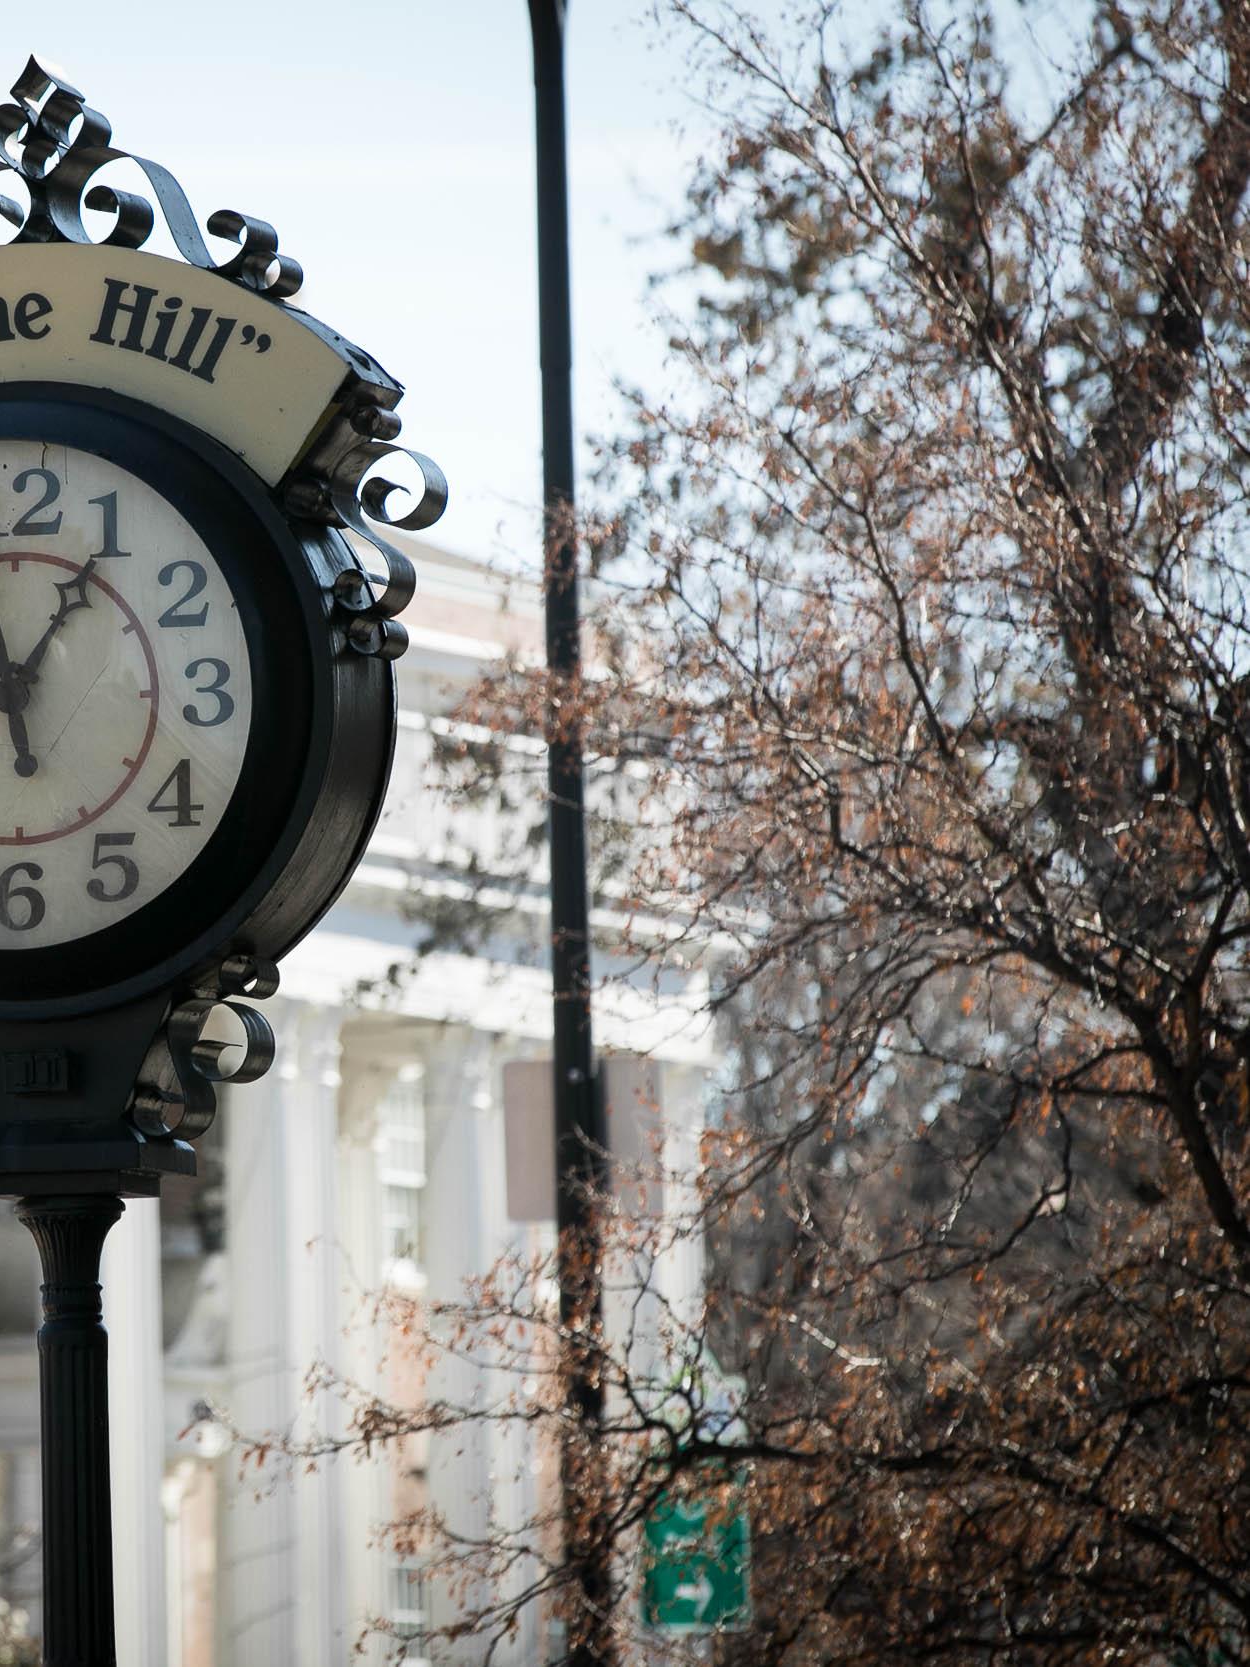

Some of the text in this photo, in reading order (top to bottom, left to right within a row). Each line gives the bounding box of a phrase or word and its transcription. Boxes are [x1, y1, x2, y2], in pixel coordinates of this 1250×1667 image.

[89, 277, 272, 384] Hill”
[88, 491, 132, 558] 1
[156, 560, 210, 628] 2
[181, 657, 235, 727] 3
[146, 758, 205, 828] 4
[85, 831, 140, 902] 5
